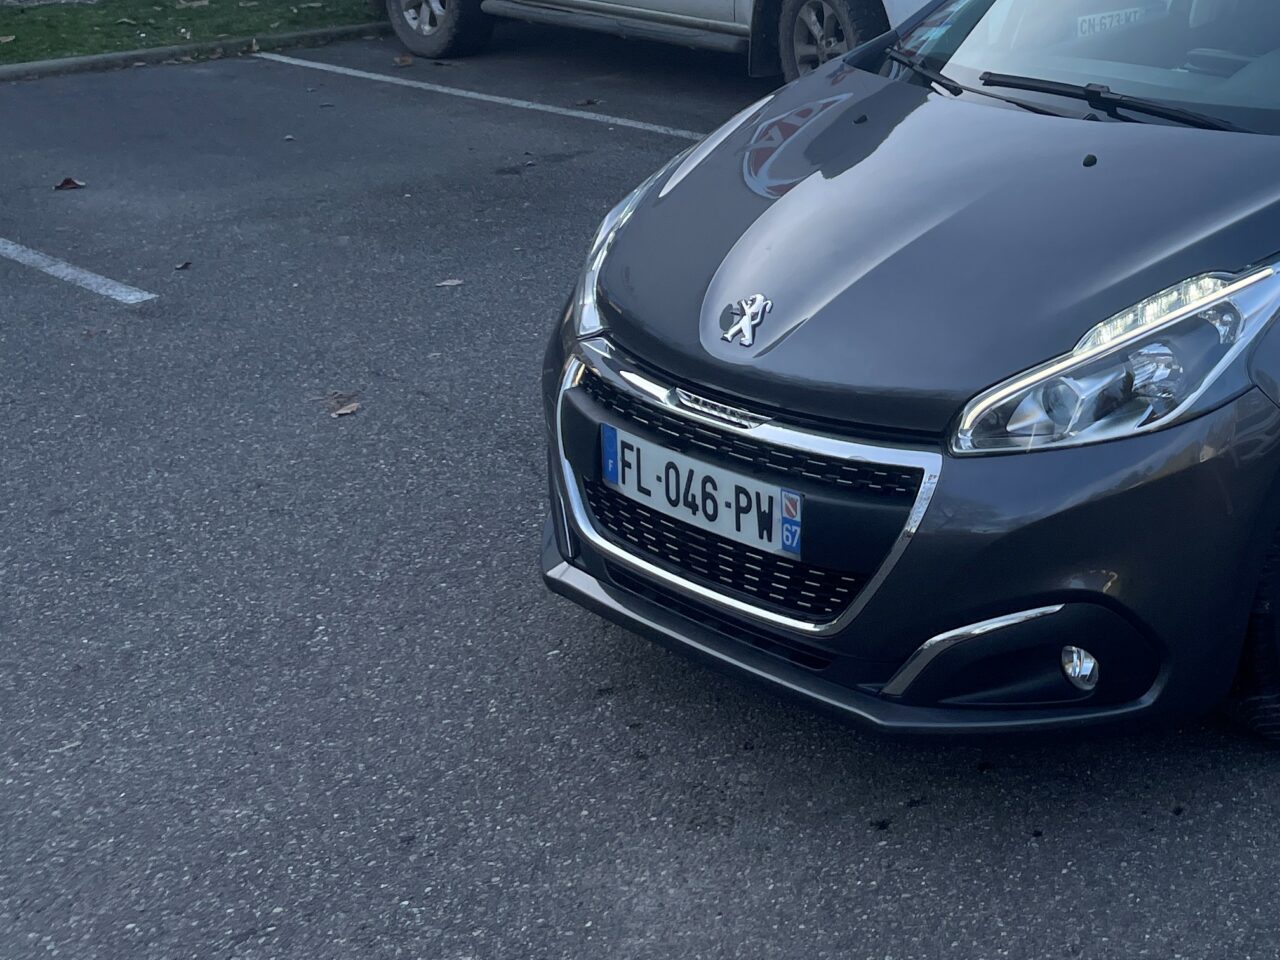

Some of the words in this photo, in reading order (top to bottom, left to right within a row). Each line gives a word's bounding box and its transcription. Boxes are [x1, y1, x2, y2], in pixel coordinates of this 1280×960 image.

[608, 459, 614, 472] F
[620, 440, 774, 543] FL-046-PW
[783, 523, 800, 547] 67
